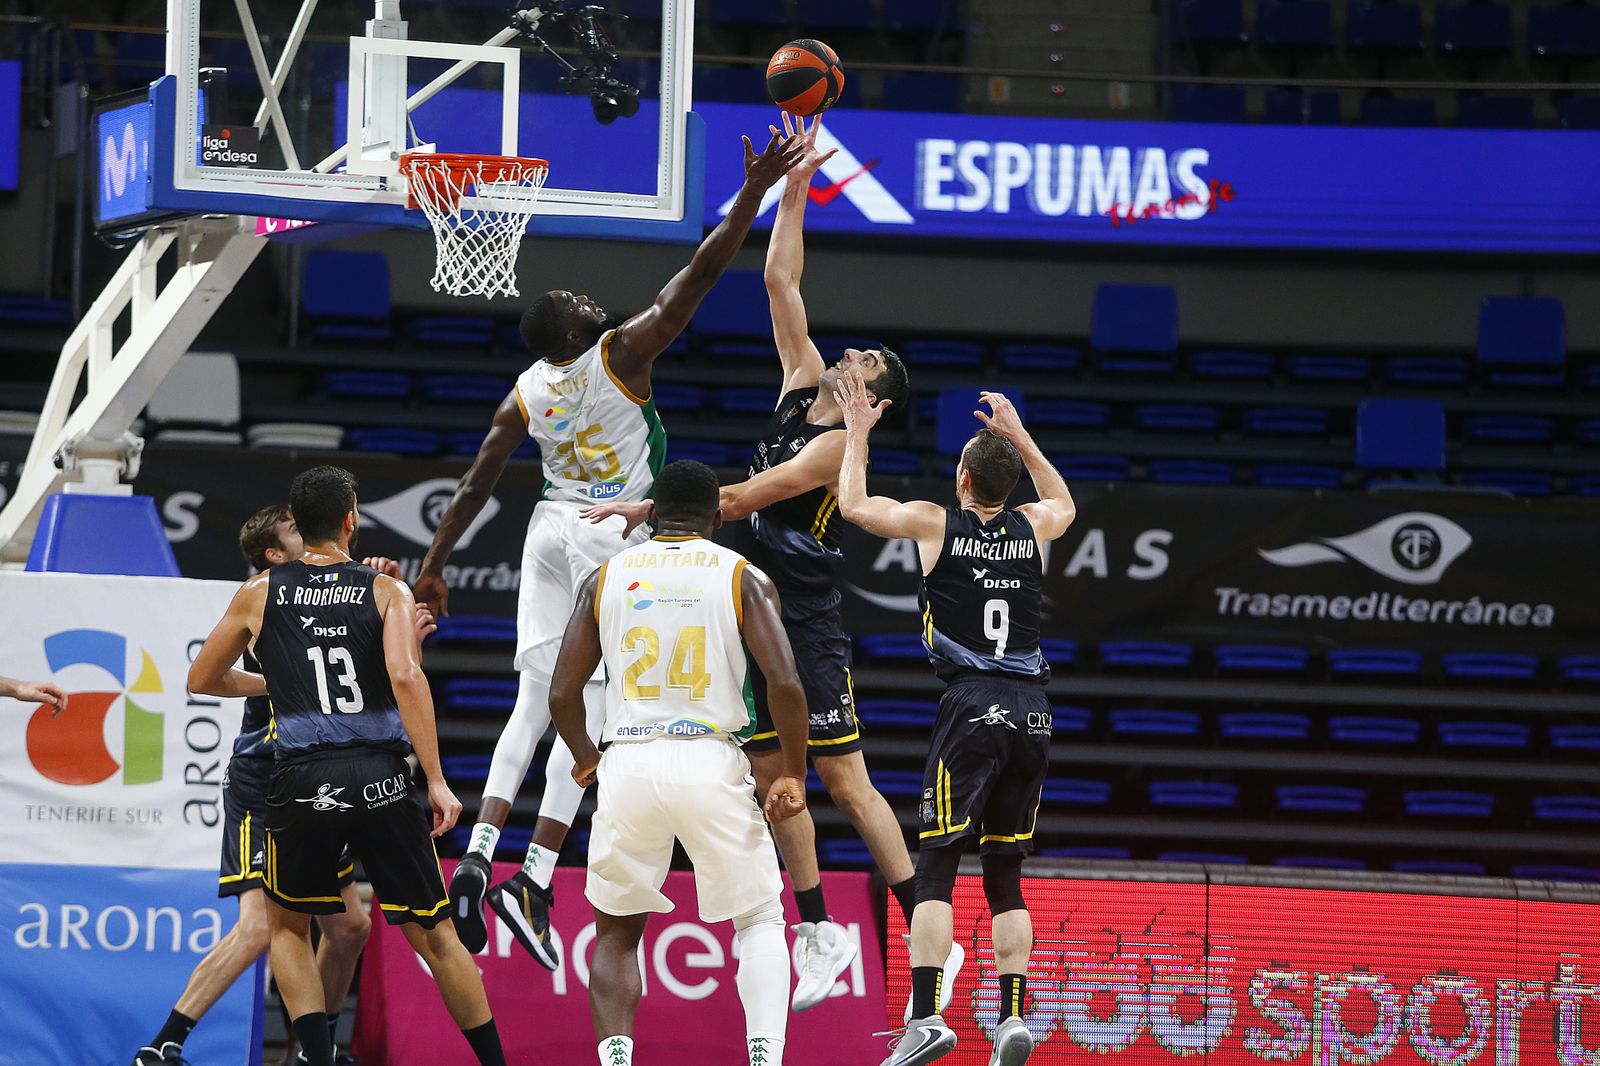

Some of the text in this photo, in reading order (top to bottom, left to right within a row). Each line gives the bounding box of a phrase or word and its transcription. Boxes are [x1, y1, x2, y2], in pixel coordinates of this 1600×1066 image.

[203, 135, 228, 150] liga
[203, 149, 257, 163] endesa
[916, 138, 1209, 220] ESPUMAS
[556, 422, 621, 481] 35
[594, 484, 621, 498] plus
[951, 536, 1034, 561] MARCELINHO
[276, 583, 367, 607] S. RODRÍGUEZ
[1215, 586, 1555, 627] Trasmediterránea
[983, 599, 1009, 659] 9
[621, 625, 712, 702] 24
[306, 646, 364, 715] 13
[672, 723, 706, 735] plus
[363, 773, 406, 801] CICAR
[25, 804, 163, 824] TENERIFE SUR
